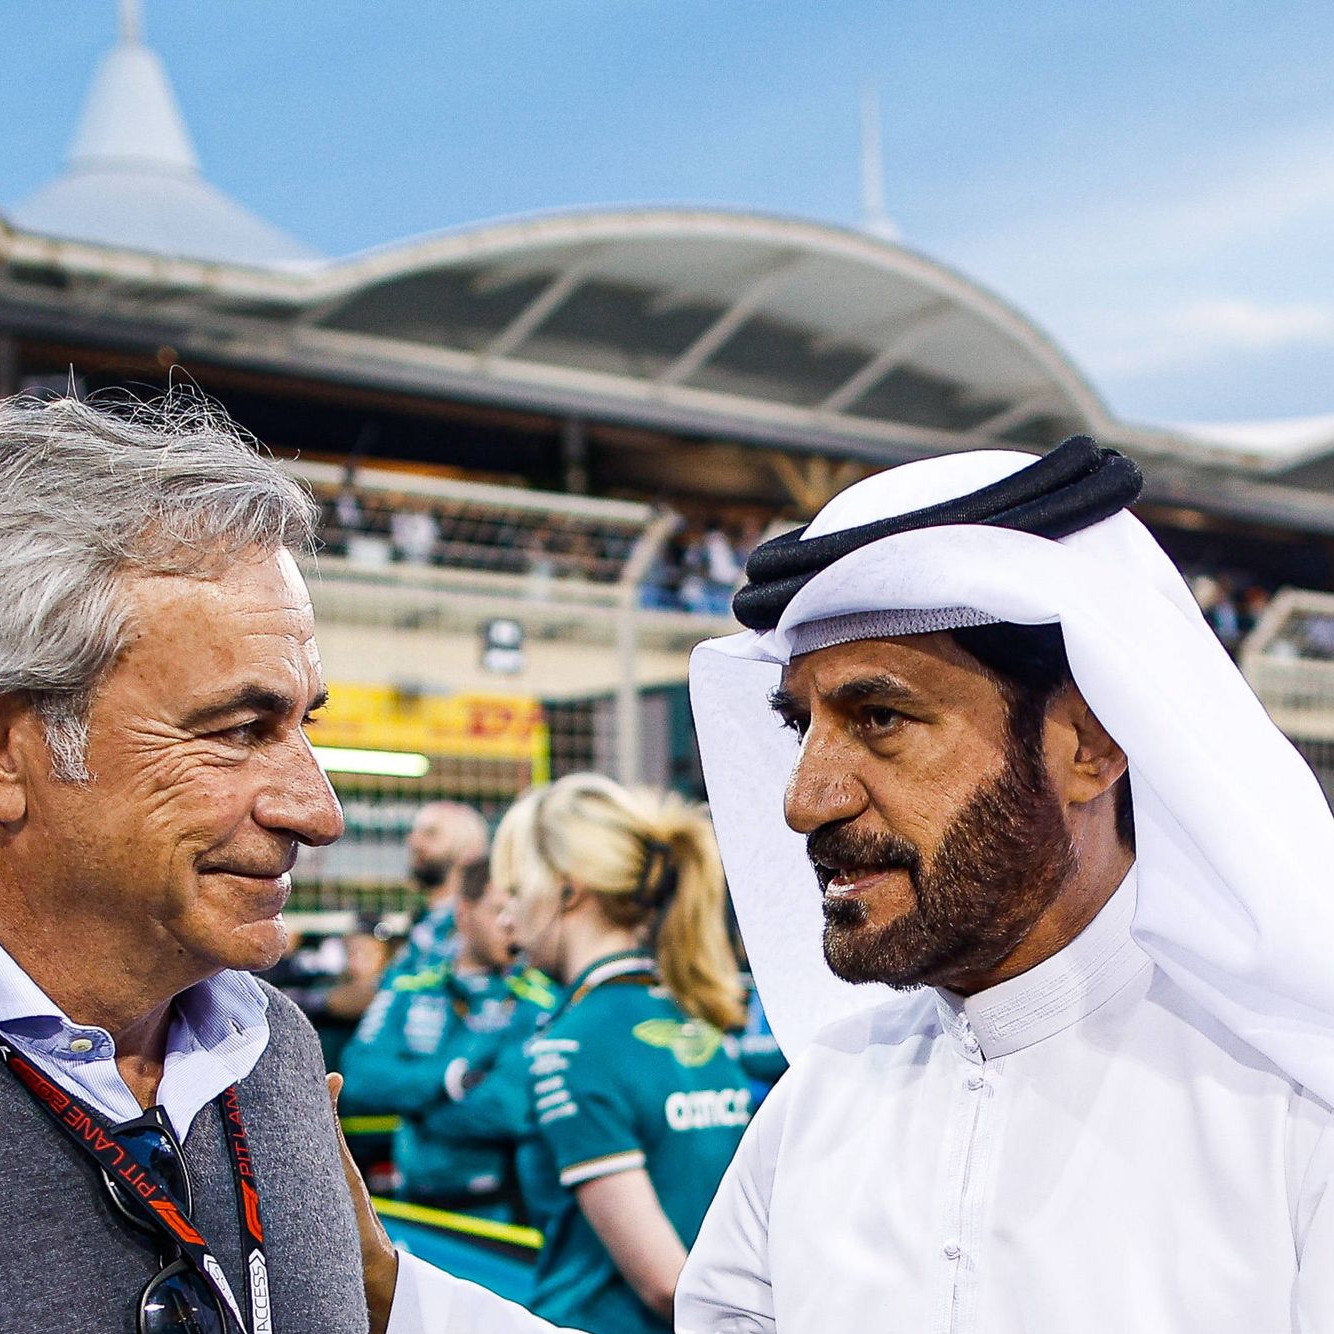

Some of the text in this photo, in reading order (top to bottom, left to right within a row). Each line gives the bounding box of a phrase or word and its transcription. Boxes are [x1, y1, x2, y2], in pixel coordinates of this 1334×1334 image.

[63, 1105, 127, 1166] LANE
[234, 1142, 254, 1177] PIT
[119, 1164, 157, 1198] PIT
[252, 1265, 269, 1332] ACCESS
